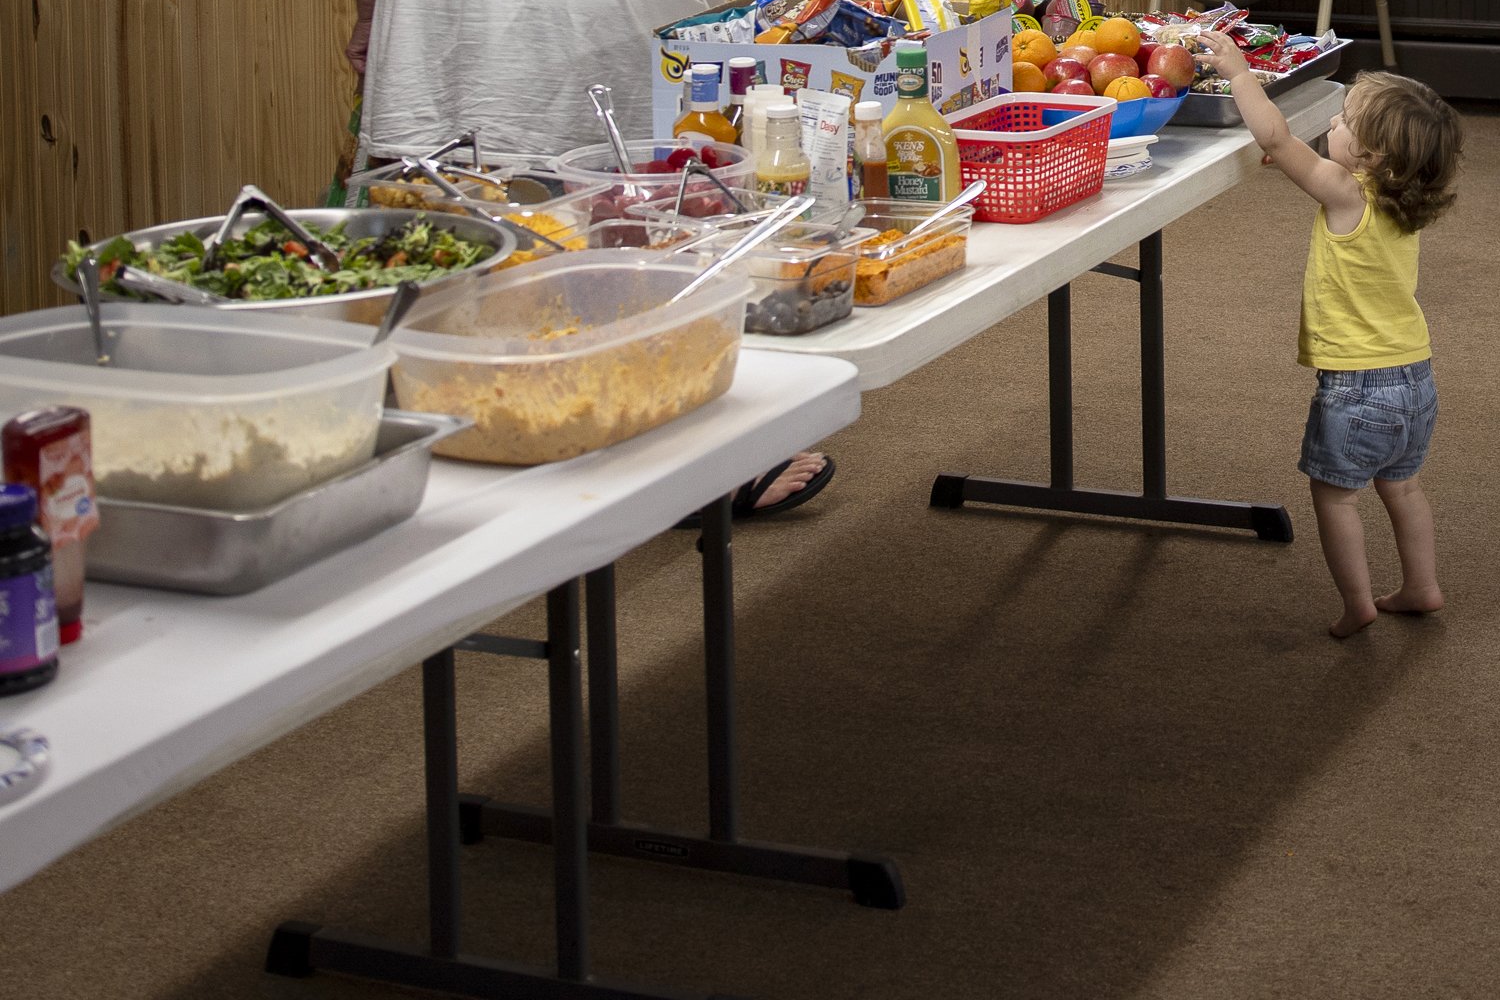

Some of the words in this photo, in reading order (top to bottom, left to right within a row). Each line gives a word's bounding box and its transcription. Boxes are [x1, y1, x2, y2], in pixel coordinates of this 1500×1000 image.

[875, 72, 898, 84] MUN
[931, 62, 942, 83] 50
[874, 85, 893, 96] GOOD
[820, 120, 839, 135] Daisy
[894, 141, 925, 151] KEN'S
[898, 176, 925, 187] Honey
[895, 184, 928, 195] Mustard
